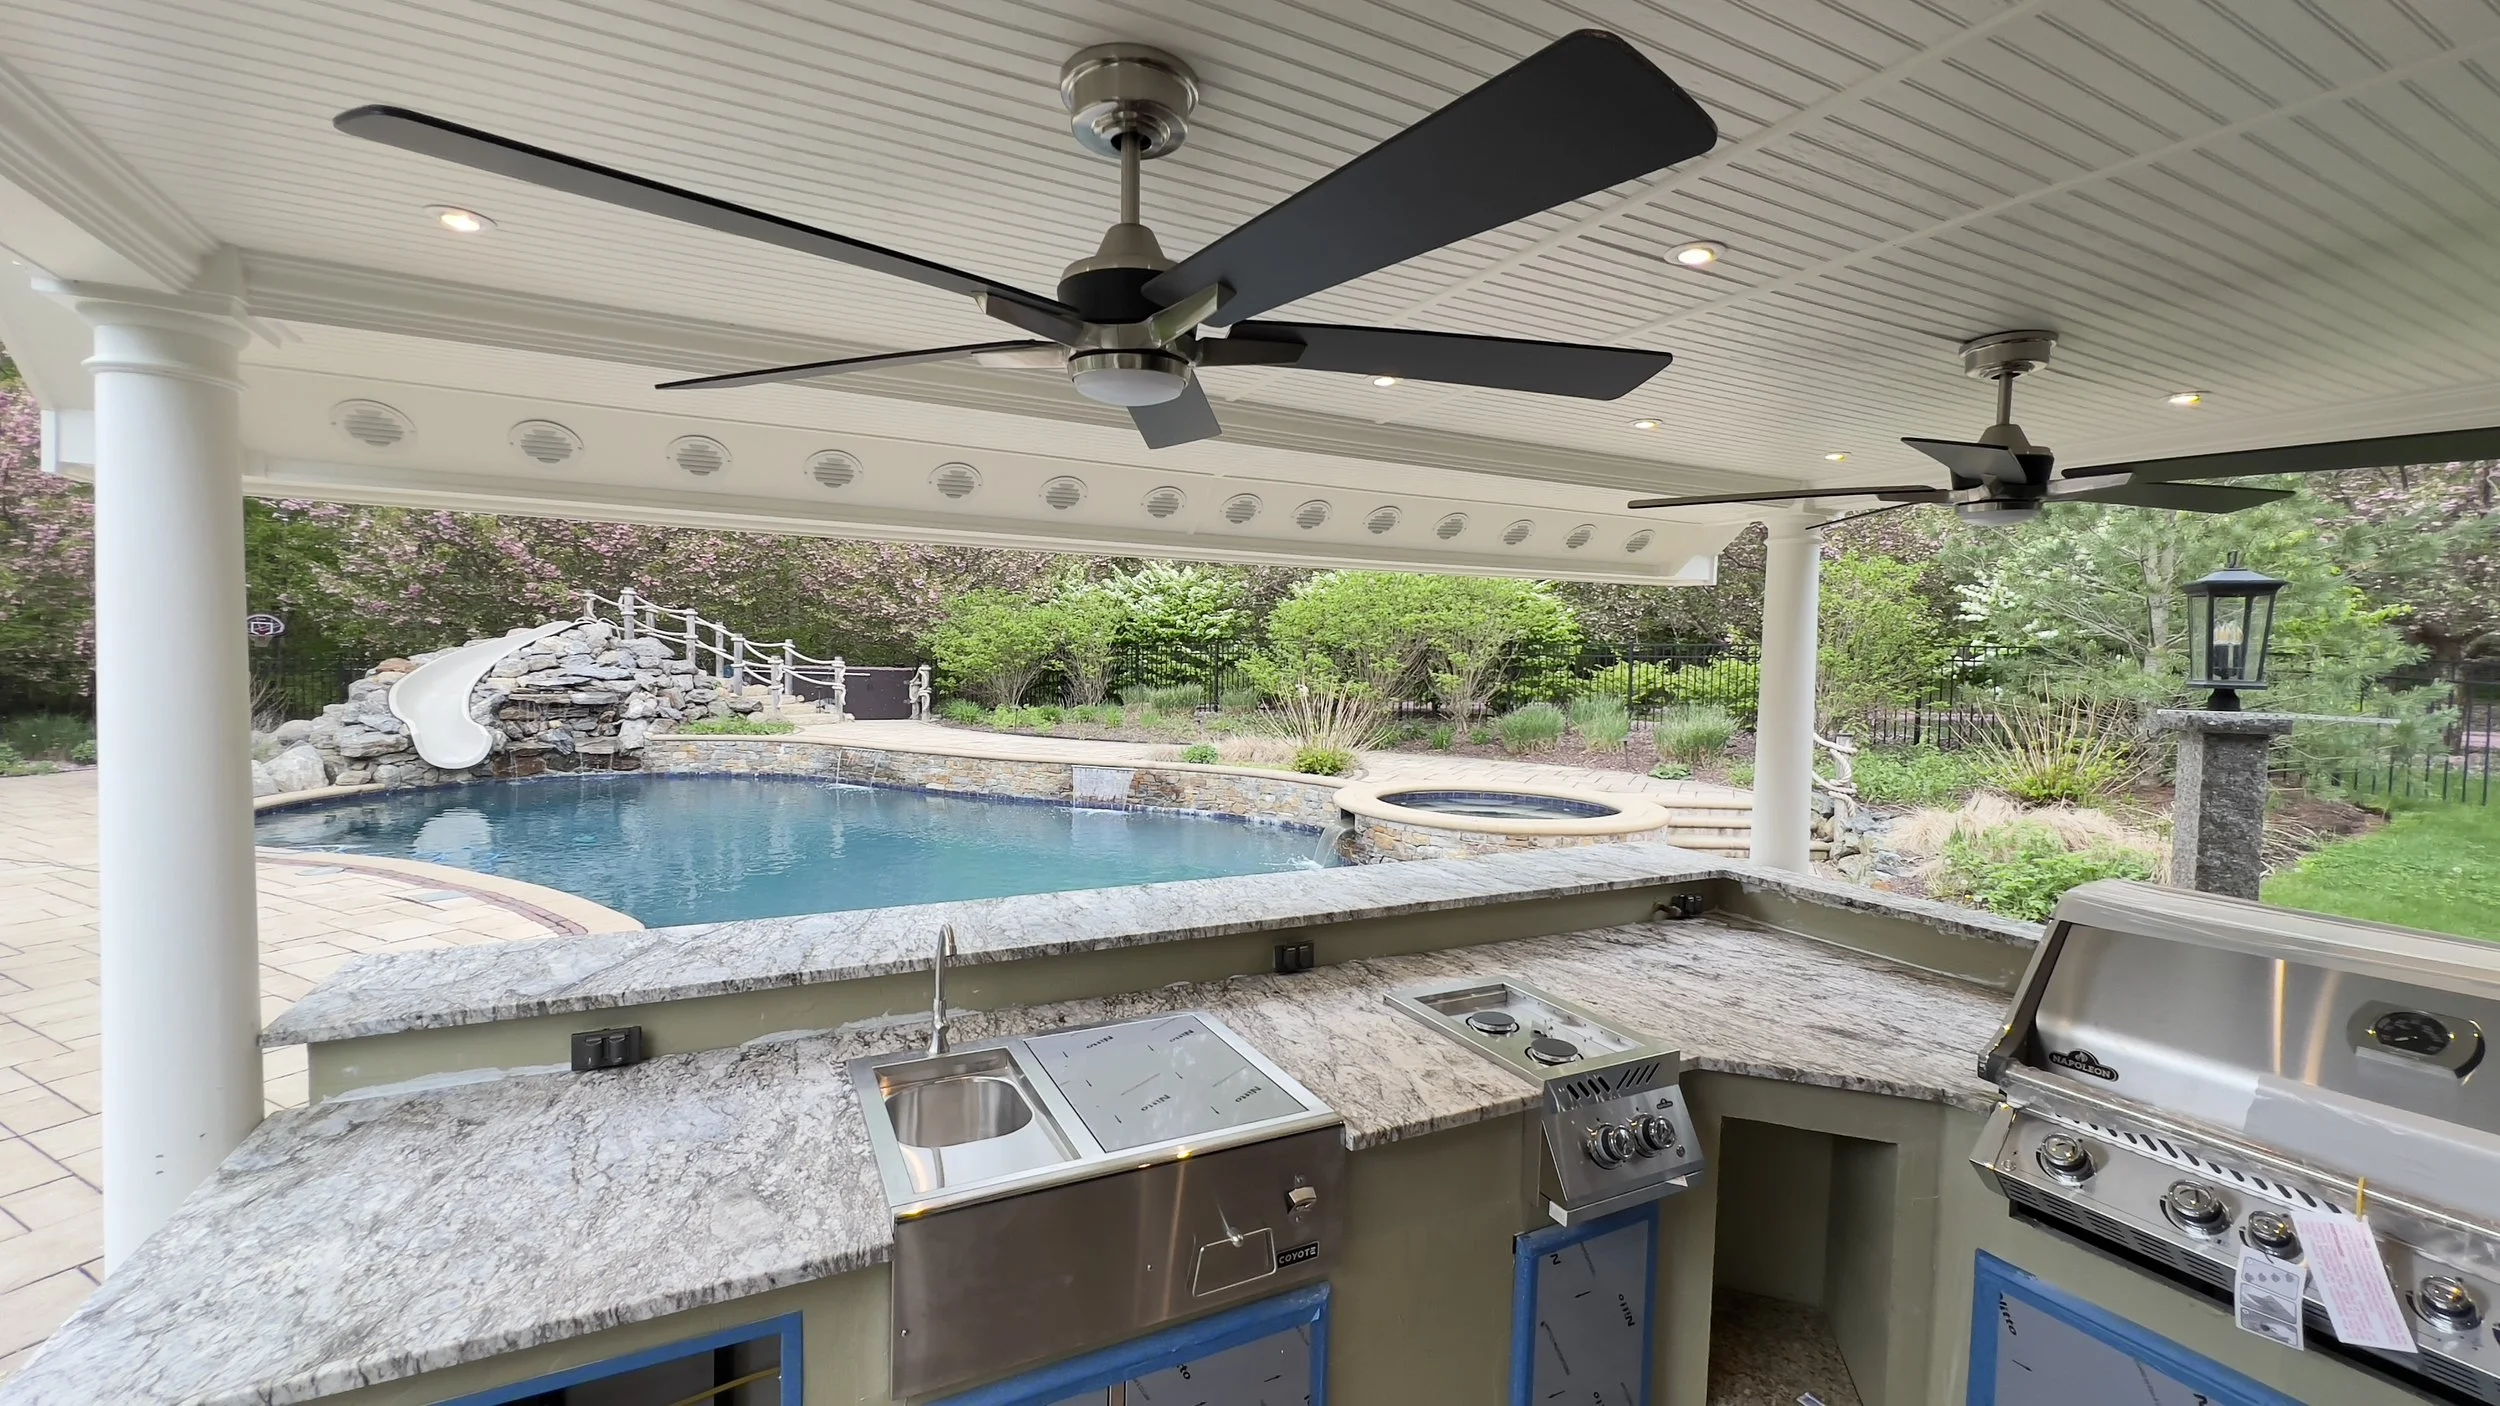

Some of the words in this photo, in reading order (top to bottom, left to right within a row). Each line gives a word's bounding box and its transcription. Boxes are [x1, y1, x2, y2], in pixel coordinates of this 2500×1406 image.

[2052, 1054, 2111, 1079] NAPOLEON
[1140, 1093, 1172, 1112] Nitto
[1235, 1085, 1262, 1103] Nitto
[1279, 1246, 1317, 1264] COYOTE
[1618, 1293, 1636, 1327] Nitto
